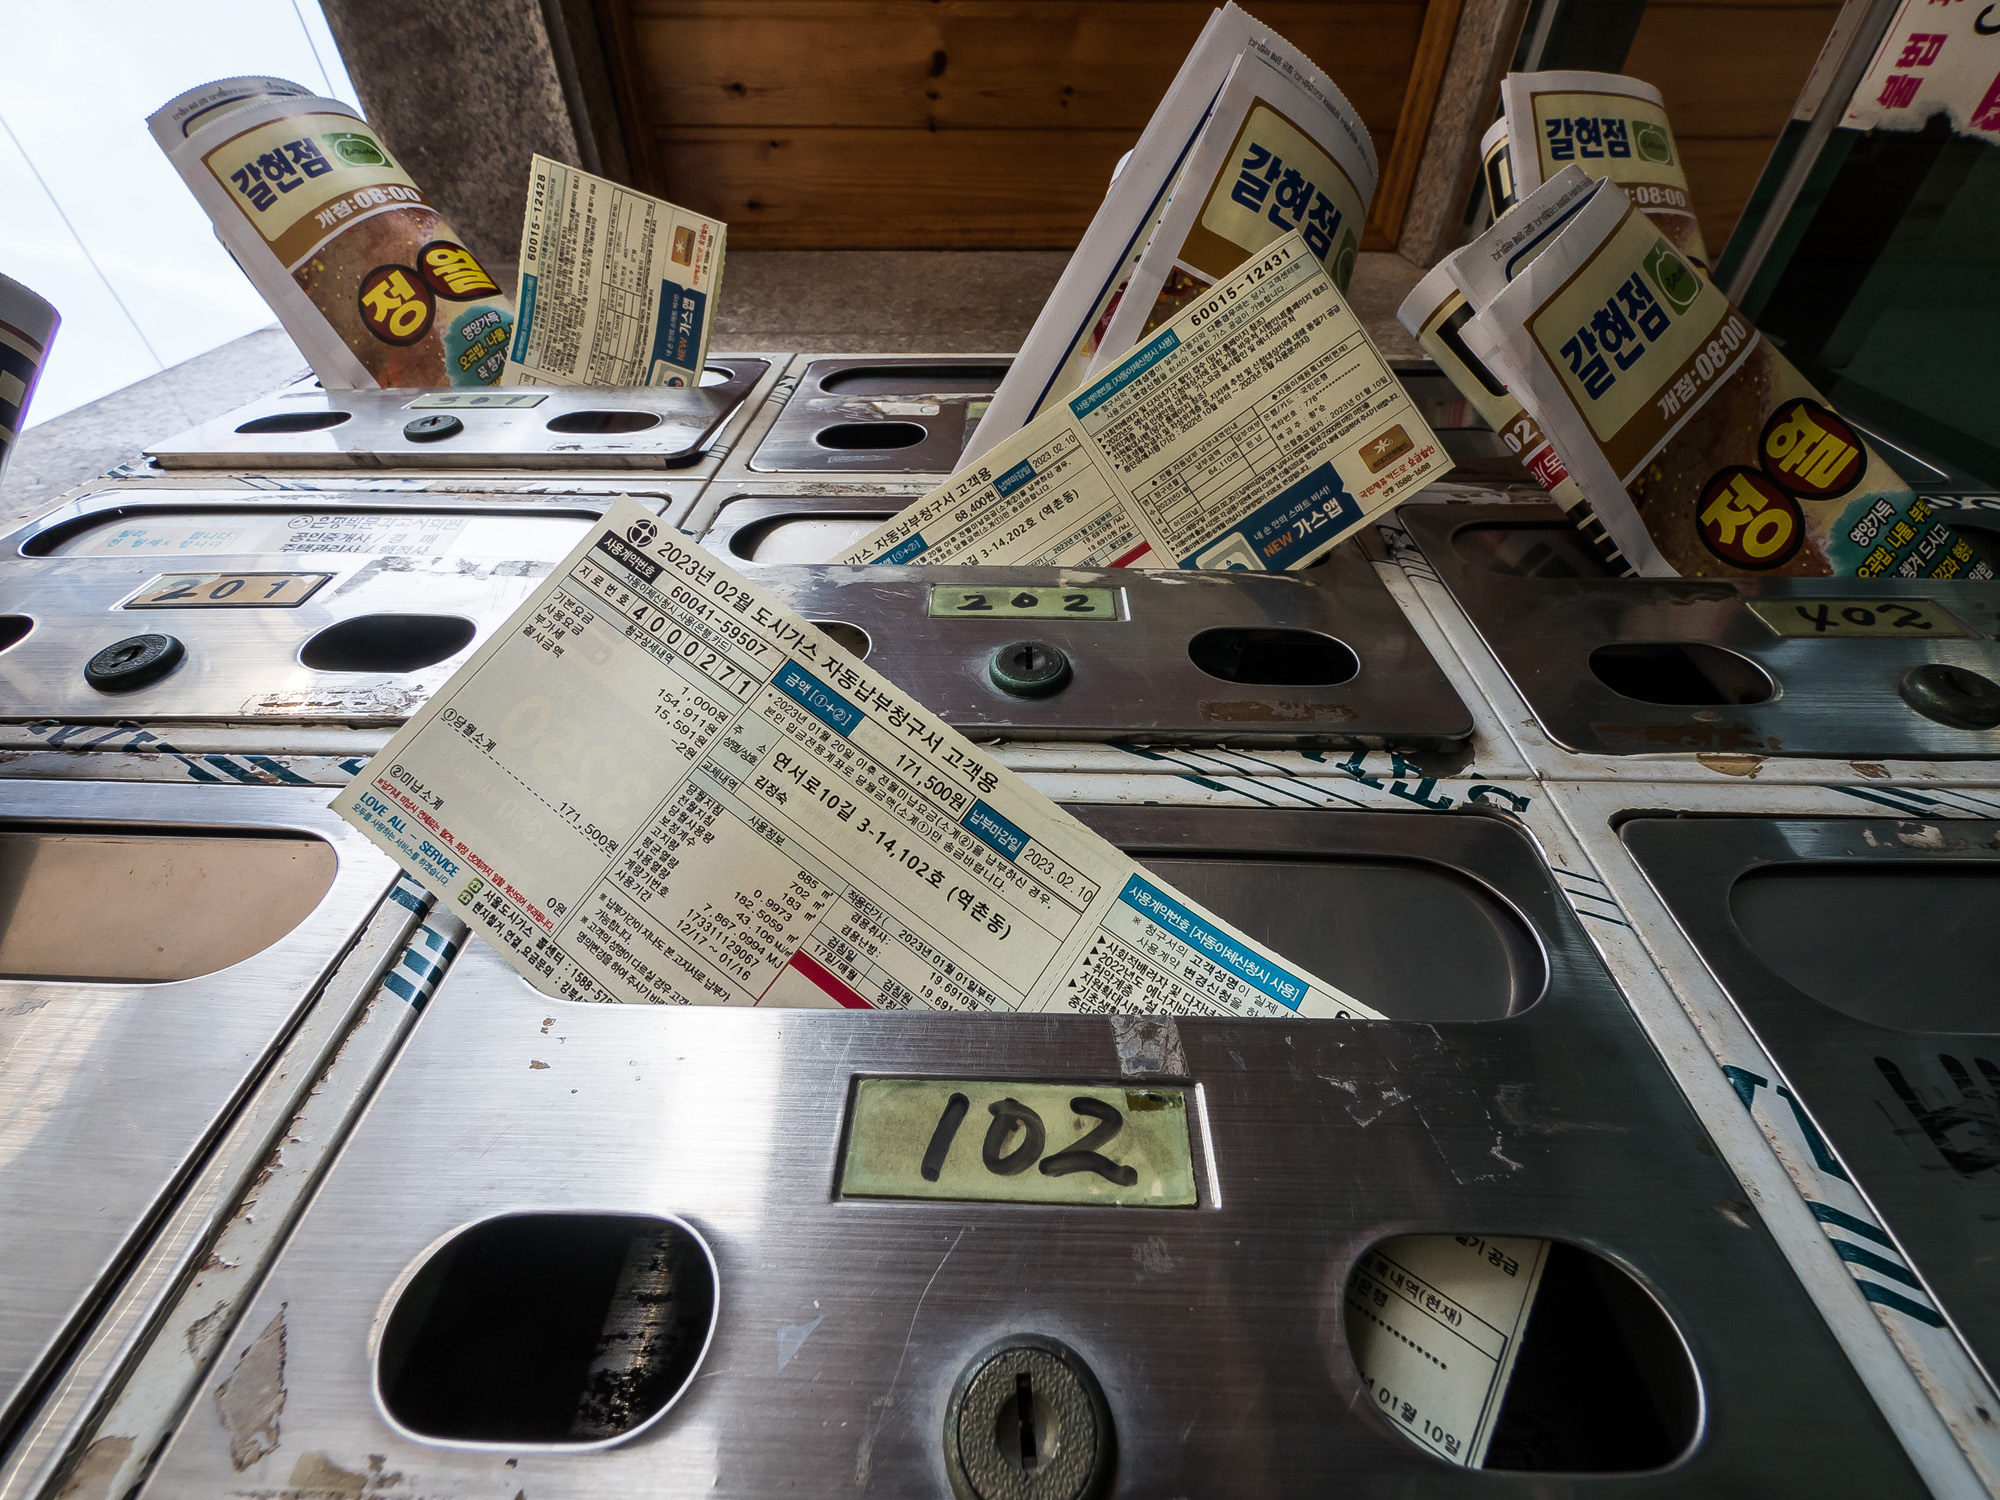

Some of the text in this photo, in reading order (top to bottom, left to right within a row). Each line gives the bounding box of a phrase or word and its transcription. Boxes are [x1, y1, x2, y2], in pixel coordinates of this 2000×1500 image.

[1545, 117, 1631, 161] 갈현점
[230, 137, 333, 212] 갈현점
[315, 186, 421, 229] 개점:08:00
[1231, 143, 1342, 262] 갈현점
[527, 173, 546, 260] 60015-12428
[1191, 248, 1289, 327] 60015-12431
[459, 330, 509, 371] 오곡밥, 나물,
[461, 312, 500, 340] 영양가득
[677, 298, 694, 361] NEW 가스앱
[1559, 271, 1672, 401] 갈현점
[477, 368, 489, 379] 꼭
[1329, 399, 1354, 419] 2023년
[1372, 376, 1387, 389] 10일
[1657, 316, 1747, 420] 개점:08:00
[874, 466, 993, 550] 자동납부청구서 고객용
[954, 434, 1076, 522] 68,400원 납부마감일 2023.02.10
[1271, 486, 1331, 528] 안의 스마트 비서!
[280, 544, 360, 553] 주택관리사
[290, 532, 371, 542] 공인중개사
[980, 487, 1080, 558] 3-14,202호 (역촌동)
[1263, 497, 1344, 558] NEW 가스앱
[1850, 499, 1896, 546] 영양가득
[1887, 521, 1918, 548] 나물,
[1918, 523, 1949, 560] 드시고
[151, 579, 290, 602] 201
[602, 537, 657, 578] 사용계약번호
[670, 585, 768, 658] 60041-59507
[623, 572, 678, 614] 자동이체신청시
[957, 592, 1095, 611] 202
[1796, 603, 1932, 632] 402
[541, 602, 717, 736] 사용요금 154,911원
[552, 591, 727, 724] 기본요금 1,000원
[624, 624, 675, 664] 청구상세내역
[656, 539, 717, 590] 2023년
[711, 578, 755, 617] 02월
[748, 604, 821, 665] 도시가스
[816, 654, 944, 755] 자동납부청구서
[939, 743, 1001, 796] 고객용
[531, 613, 707, 748] 부가세 15,591원
[700, 760, 738, 791] 교체내역
[721, 735, 759, 766] 성명/상호
[762, 706, 1008, 893] 본인 입금전용계좌로 송금바랍니다.
[772, 696, 1054, 910] 2023년 01월 20일 이후 납부하신 경우,
[783, 672, 1093, 904] 금액 171,500원 납부마감일 2023.02.10
[360, 791, 460, 878] LOVE ALL SERVICE
[556, 801, 619, 855] 171,500원
[667, 805, 801, 911] 당월사용량 183
[676, 795, 809, 900] 전월지침 702
[685, 785, 818, 889] 당월지침 885
[748, 815, 785, 846] 사용정보
[769, 750, 1013, 942] 연서로10길 3-14,102호 (역촌동)
[640, 837, 774, 944] 평균열량 43.106
[650, 826, 783, 932] 고지량 182.5059
[658, 816, 792, 922] 보정계수 0.9973
[481, 889, 536, 939] 서울도시가스
[544, 896, 567, 918] 0원
[593, 908, 634, 944] 가능합니다.
[604, 898, 666, 951] 납부기간이 지나도
[612, 869, 750, 981] 사용기간 12/17 01/16
[622, 858, 760, 968] 계량기번호 173311129067
[631, 847, 783, 969] 사용열량 7,867.0994 MJ
[827, 935, 912, 1005] 검침일 검침원
[899, 929, 994, 1005] 2023년 01월 01일부터
[1096, 952, 1146, 989] 2022년도
[1103, 941, 1169, 989] 사회적배려자
[1126, 885, 1299, 1002] 사용계약번호 사용]
[1135, 935, 1242, 1010] 사용계약 변경신청을
[1143, 923, 1278, 1015] 청구서의 고객성명이 실제
[929, 971, 977, 1012] 19.6910원
[921, 1092, 1138, 1185] 102
[1488, 1247, 1520, 1278] 공급
[1378, 1387, 1462, 1457] 01월 10일
